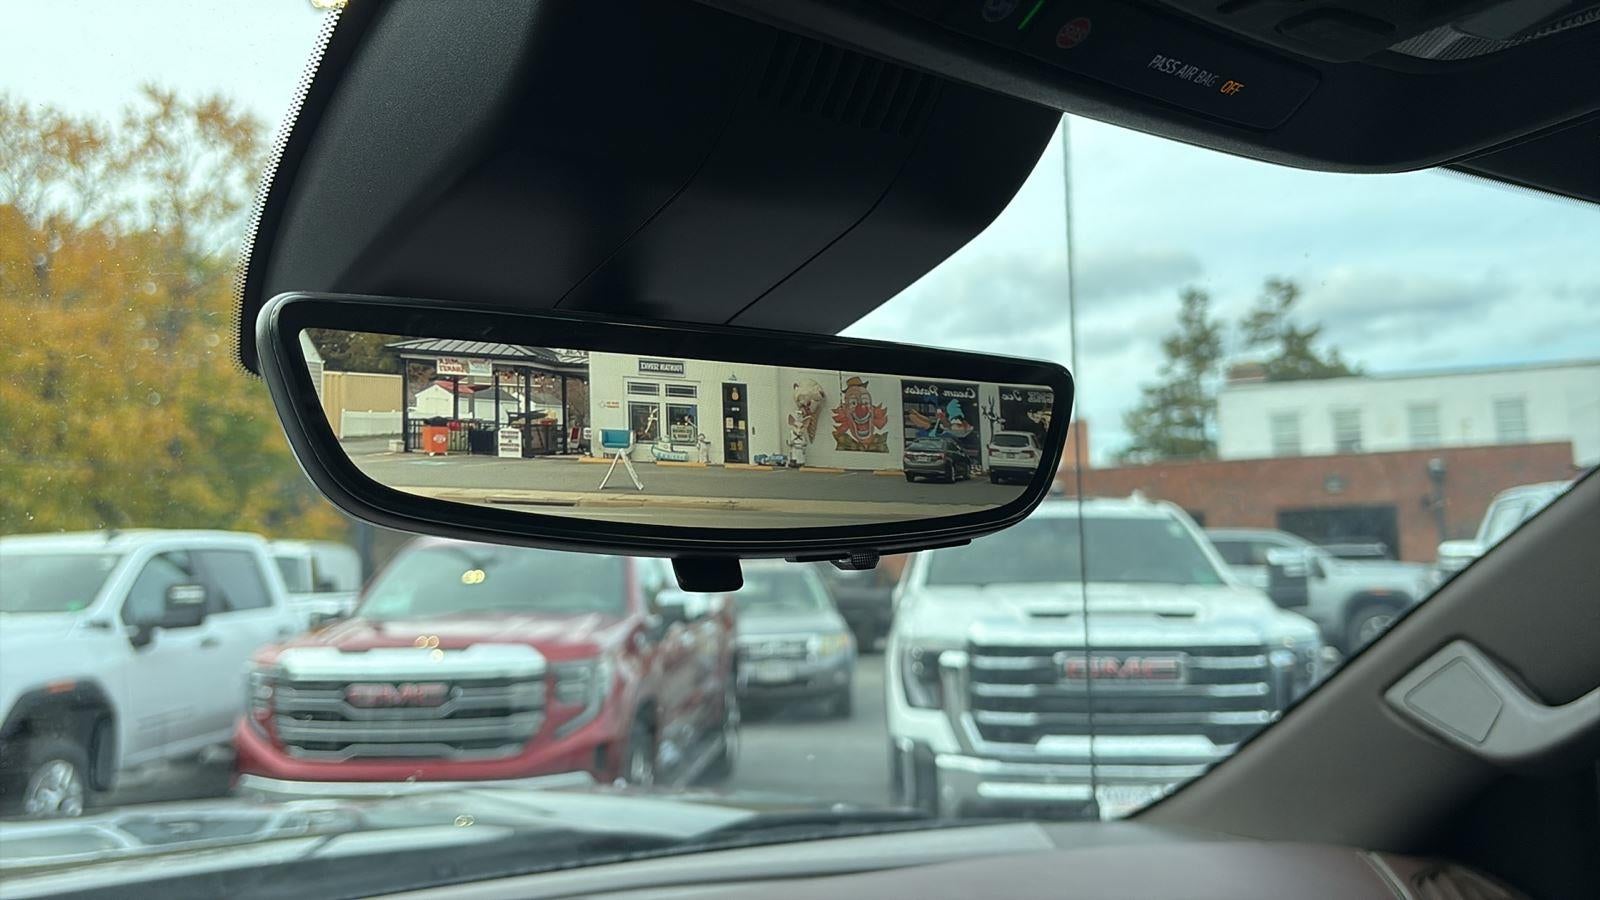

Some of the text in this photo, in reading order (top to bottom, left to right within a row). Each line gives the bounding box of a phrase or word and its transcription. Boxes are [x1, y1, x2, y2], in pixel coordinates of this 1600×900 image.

[1147, 54, 1245, 95] PASS AIR BAG OFF
